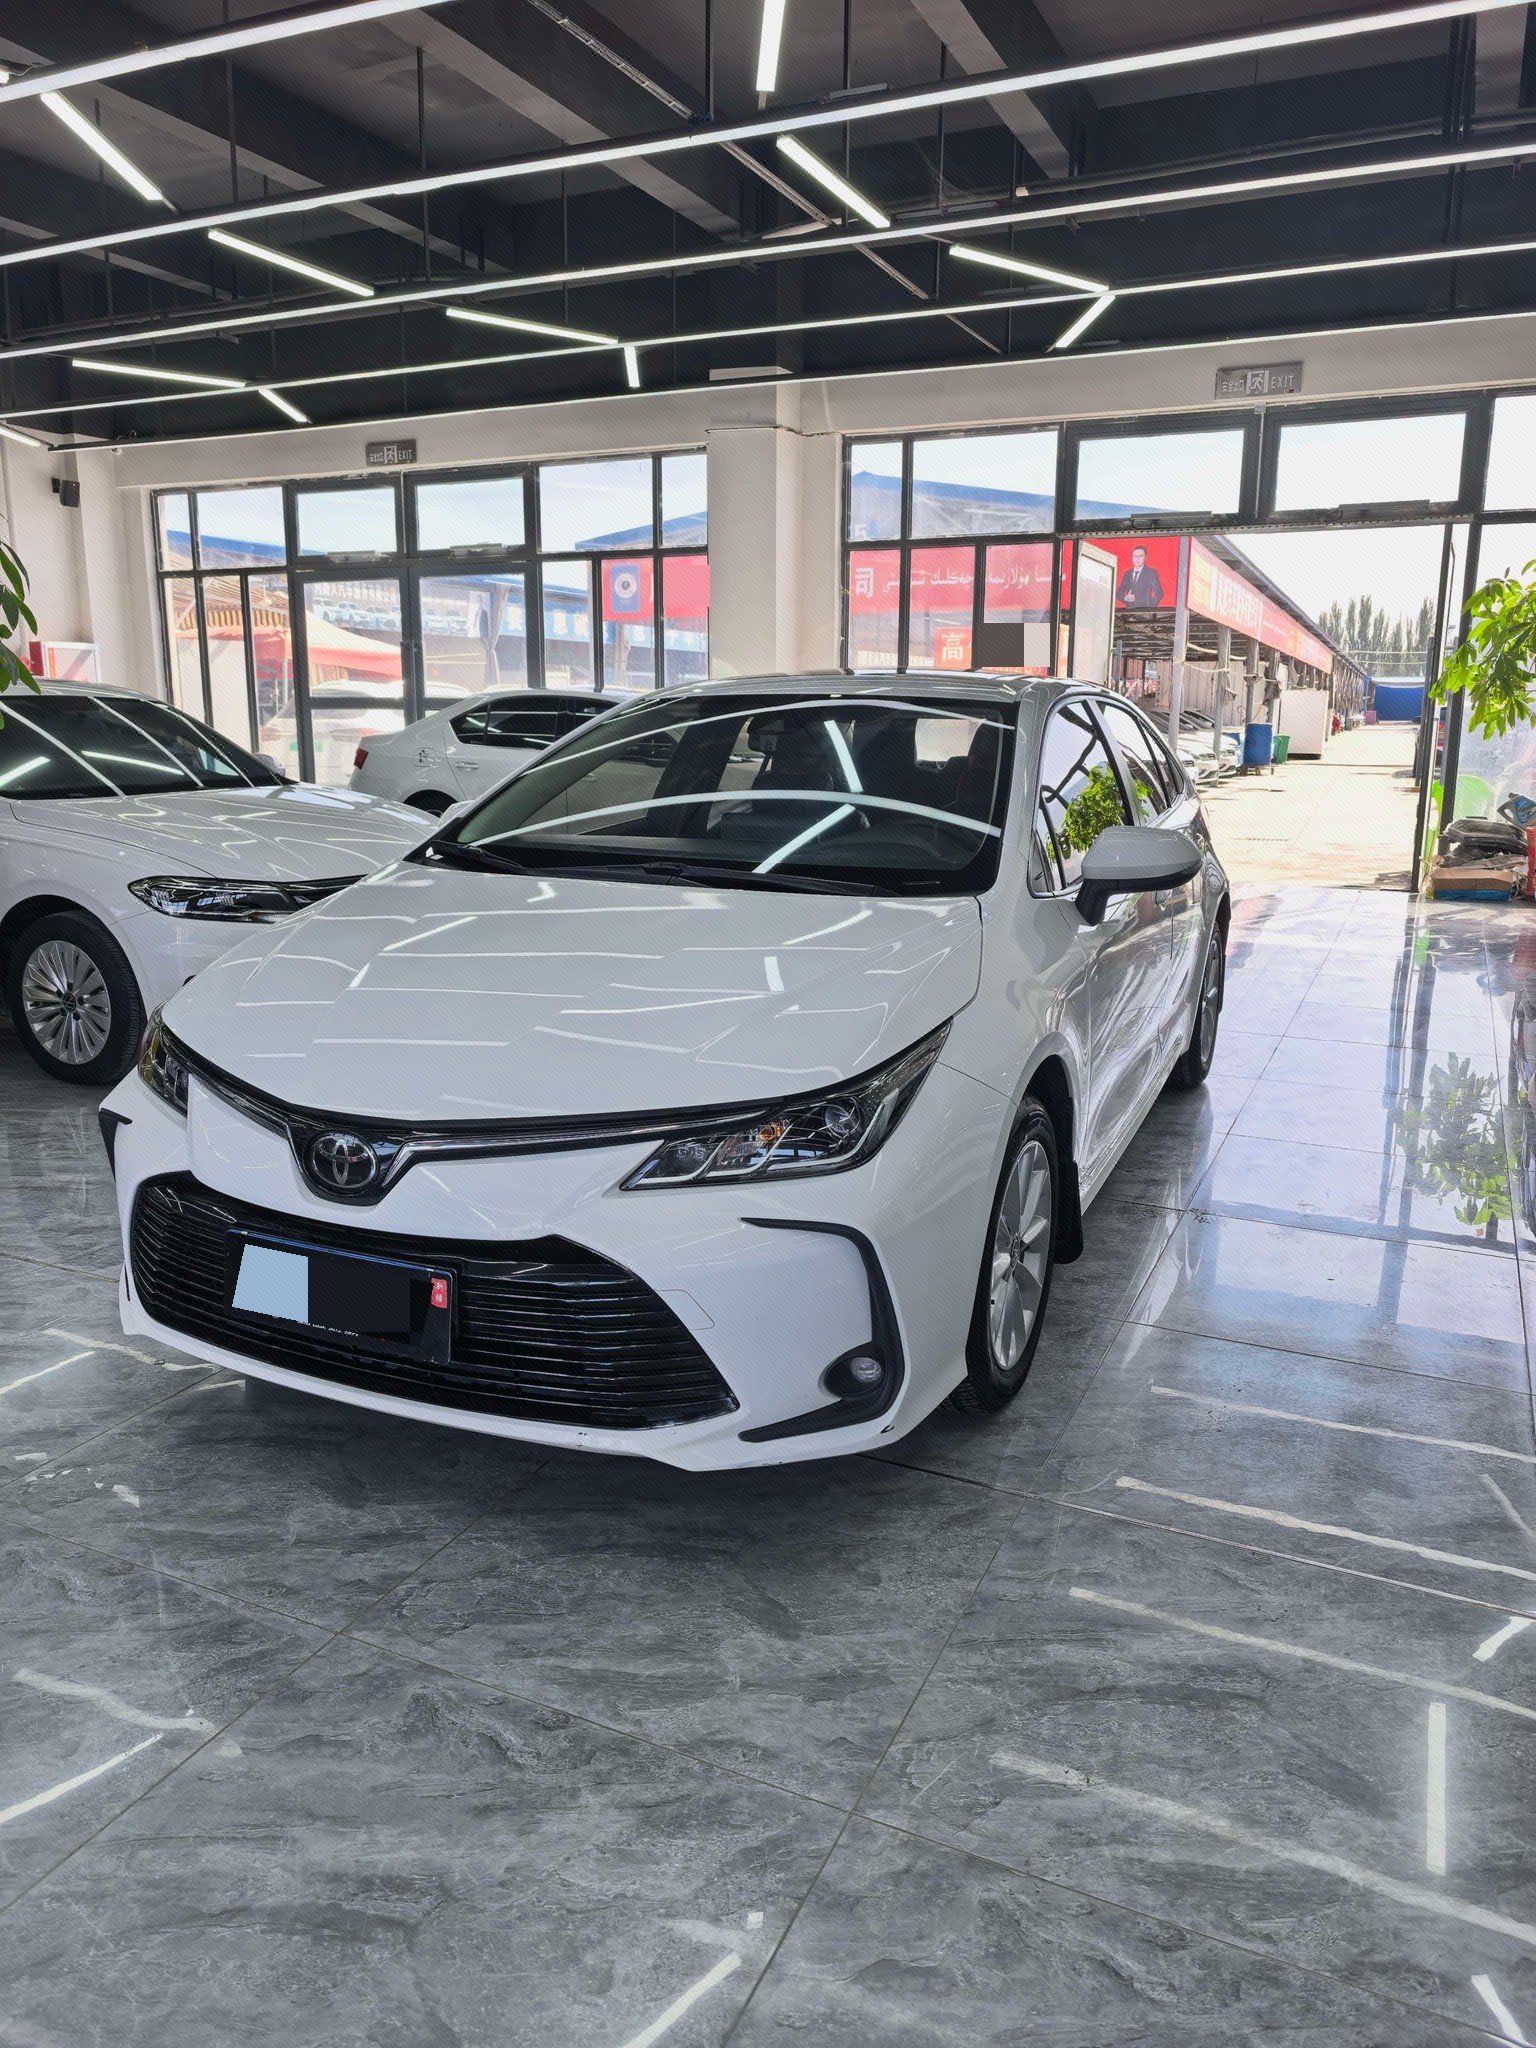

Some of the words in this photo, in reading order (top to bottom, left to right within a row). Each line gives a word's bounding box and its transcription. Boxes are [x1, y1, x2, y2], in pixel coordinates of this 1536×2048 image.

[1271, 374, 1295, 389] EXIT
[398, 449, 412, 460] EXIT
[854, 566, 874, 599] 司
[941, 632, 965, 662] 高
